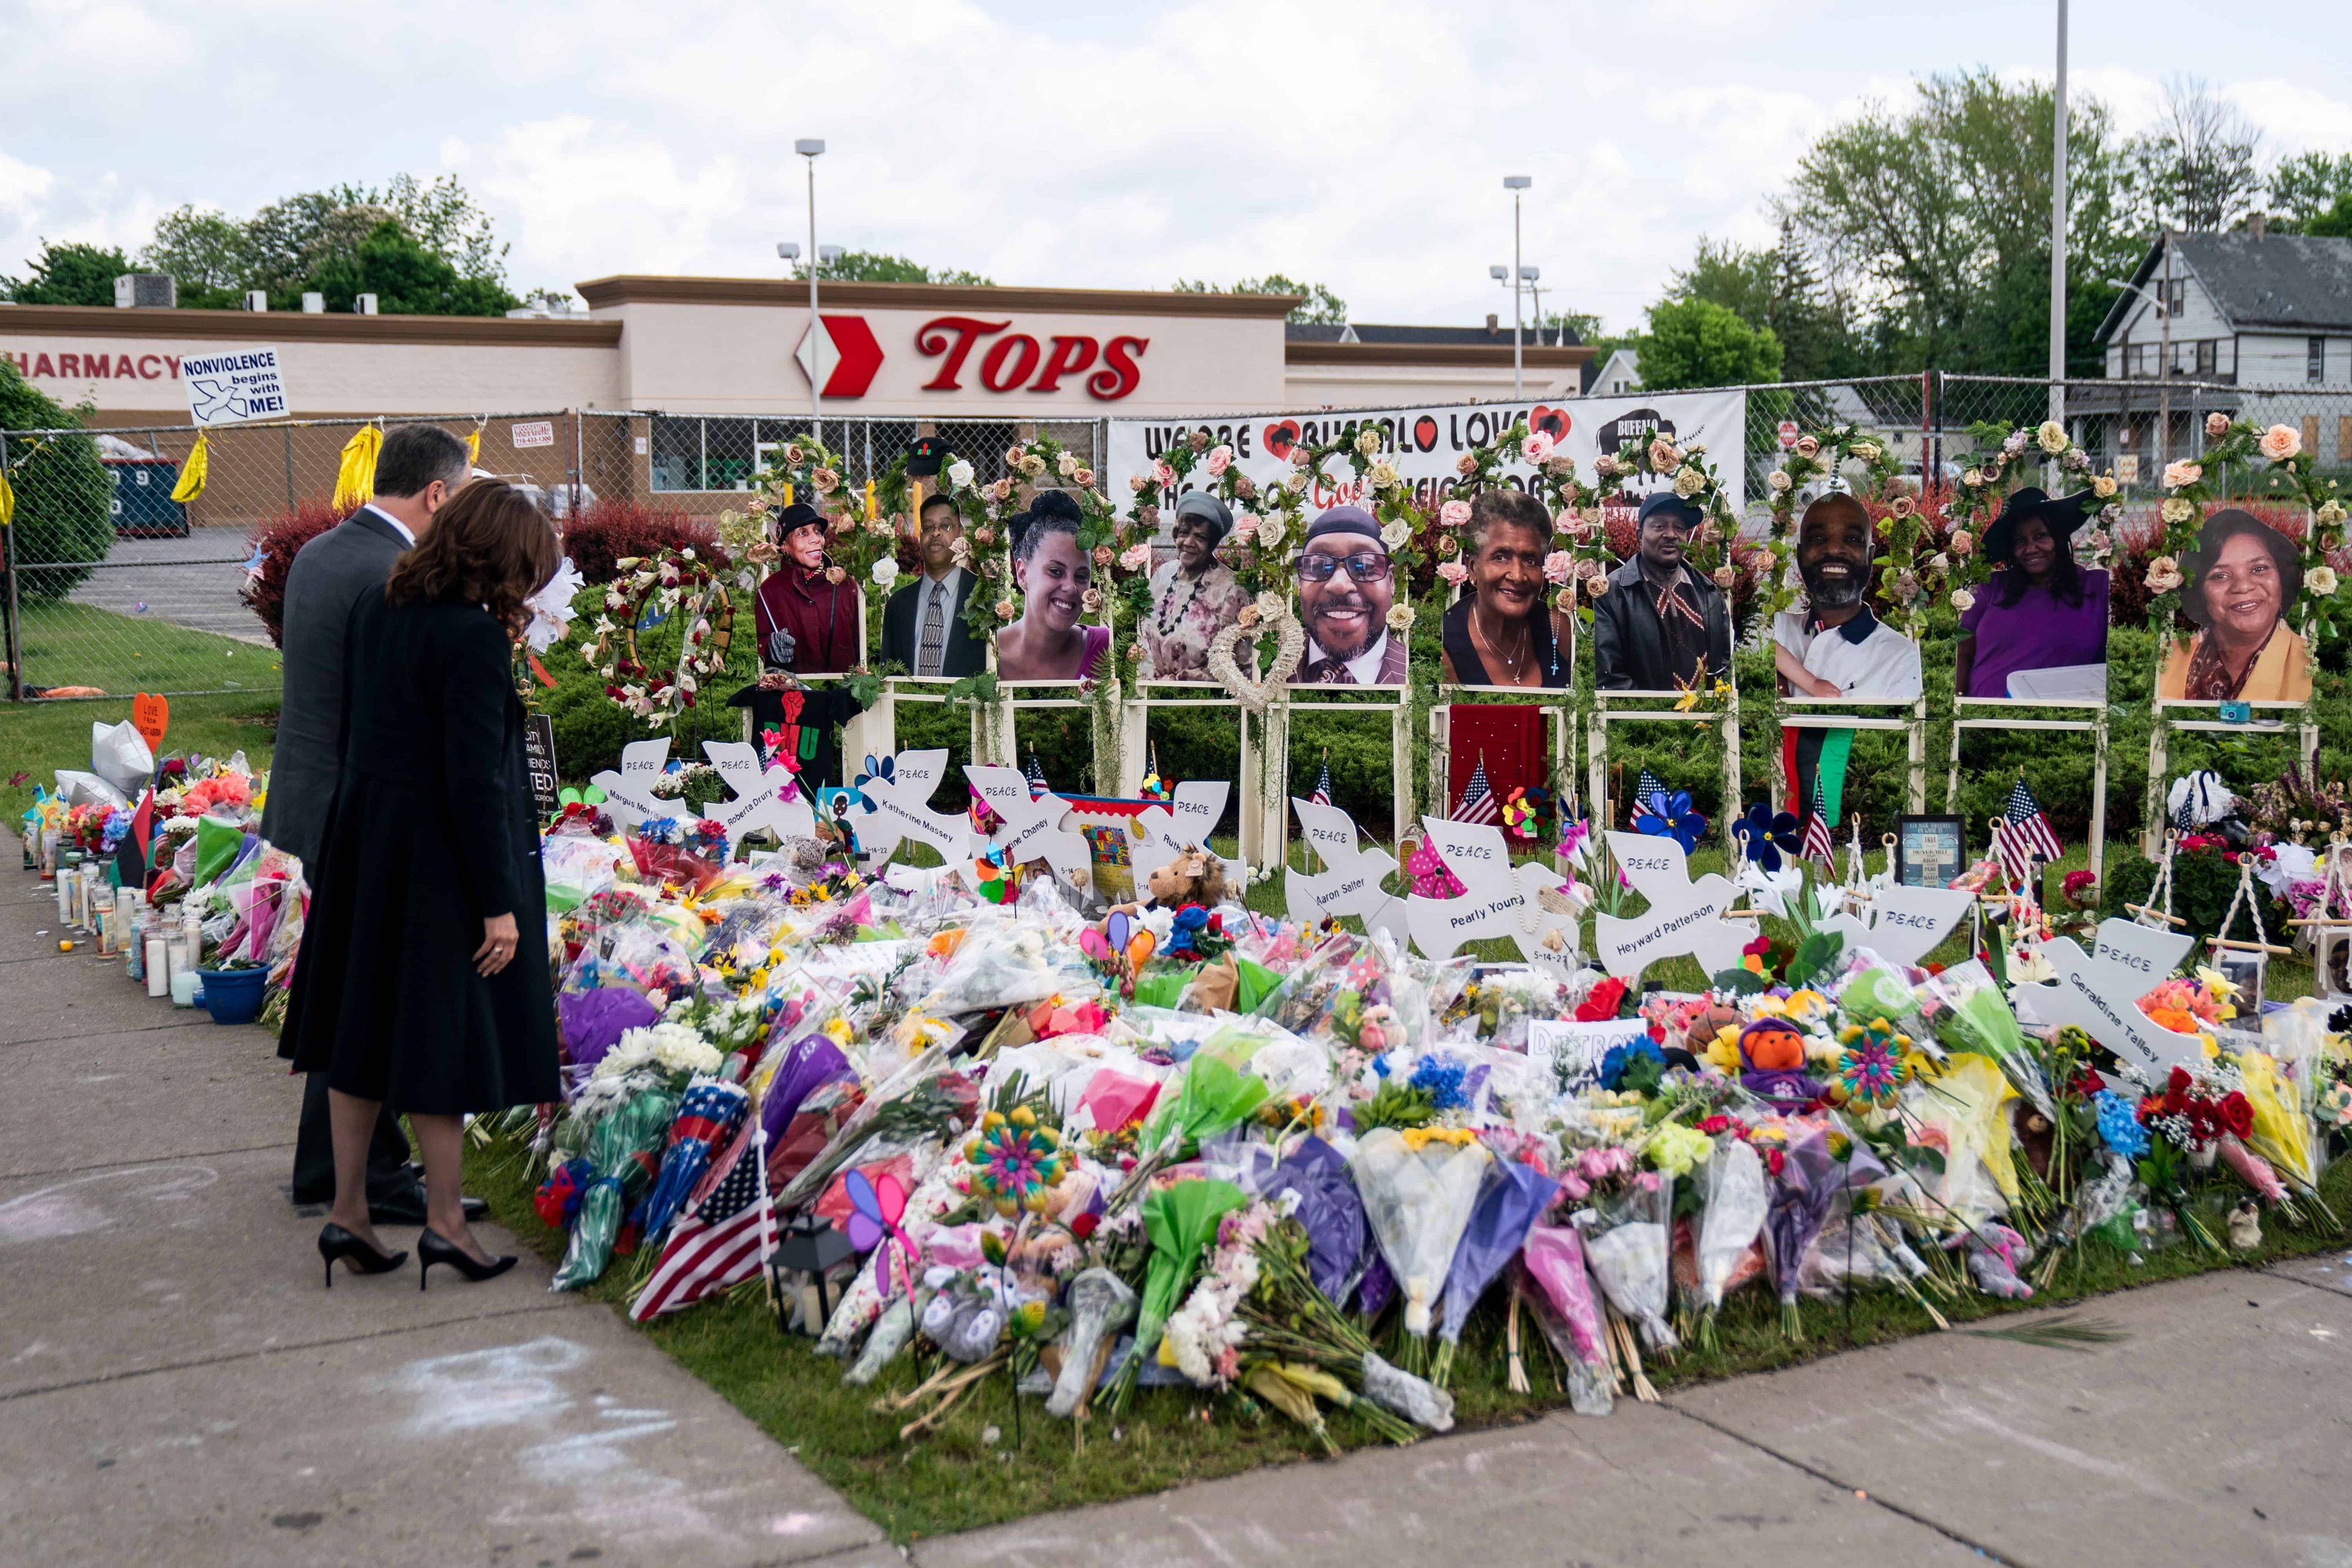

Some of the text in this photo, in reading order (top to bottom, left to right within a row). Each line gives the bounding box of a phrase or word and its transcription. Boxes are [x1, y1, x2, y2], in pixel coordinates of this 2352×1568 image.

[6, 352, 181, 379] HARMACY
[184, 352, 276, 376] NONVIOLENCE
[915, 316, 1150, 399] TOPS
[232, 372, 277, 385] begins
[250, 383, 280, 394] with
[249, 396, 284, 413] ME!
[1618, 419, 1659, 436] BUFFALO
[143, 704, 157, 716] LOVE
[526, 744, 545, 755] AMILY
[527, 758, 551, 769] IENDS
[626, 761, 655, 771] PEACE
[721, 760, 750, 770] PEACE
[899, 769, 929, 779] PEACE
[609, 790, 635, 808] Margus
[986, 786, 1017, 796] PEACE
[728, 789, 773, 826] Roberta Drury
[1178, 801, 1209, 815] PEACE
[883, 799, 954, 843] Katherine Massey
[1022, 818, 1048, 839] Chaney
[1164, 834, 1182, 853] Ruth
[1312, 829, 1348, 843] PEACE
[1446, 844, 1492, 859] PEACE
[1627, 858, 1670, 870] PEACE
[1316, 878, 1365, 906] Aaron Salter
[1450, 909, 1486, 929] Pearly
[1488, 894, 1525, 913] Young
[1887, 911, 1937, 930] PEACE
[1616, 904, 1714, 956] Heyward Patterson
[2098, 943, 2152, 971] PEACE
[2070, 973, 2160, 1063] Geraldine Talley
